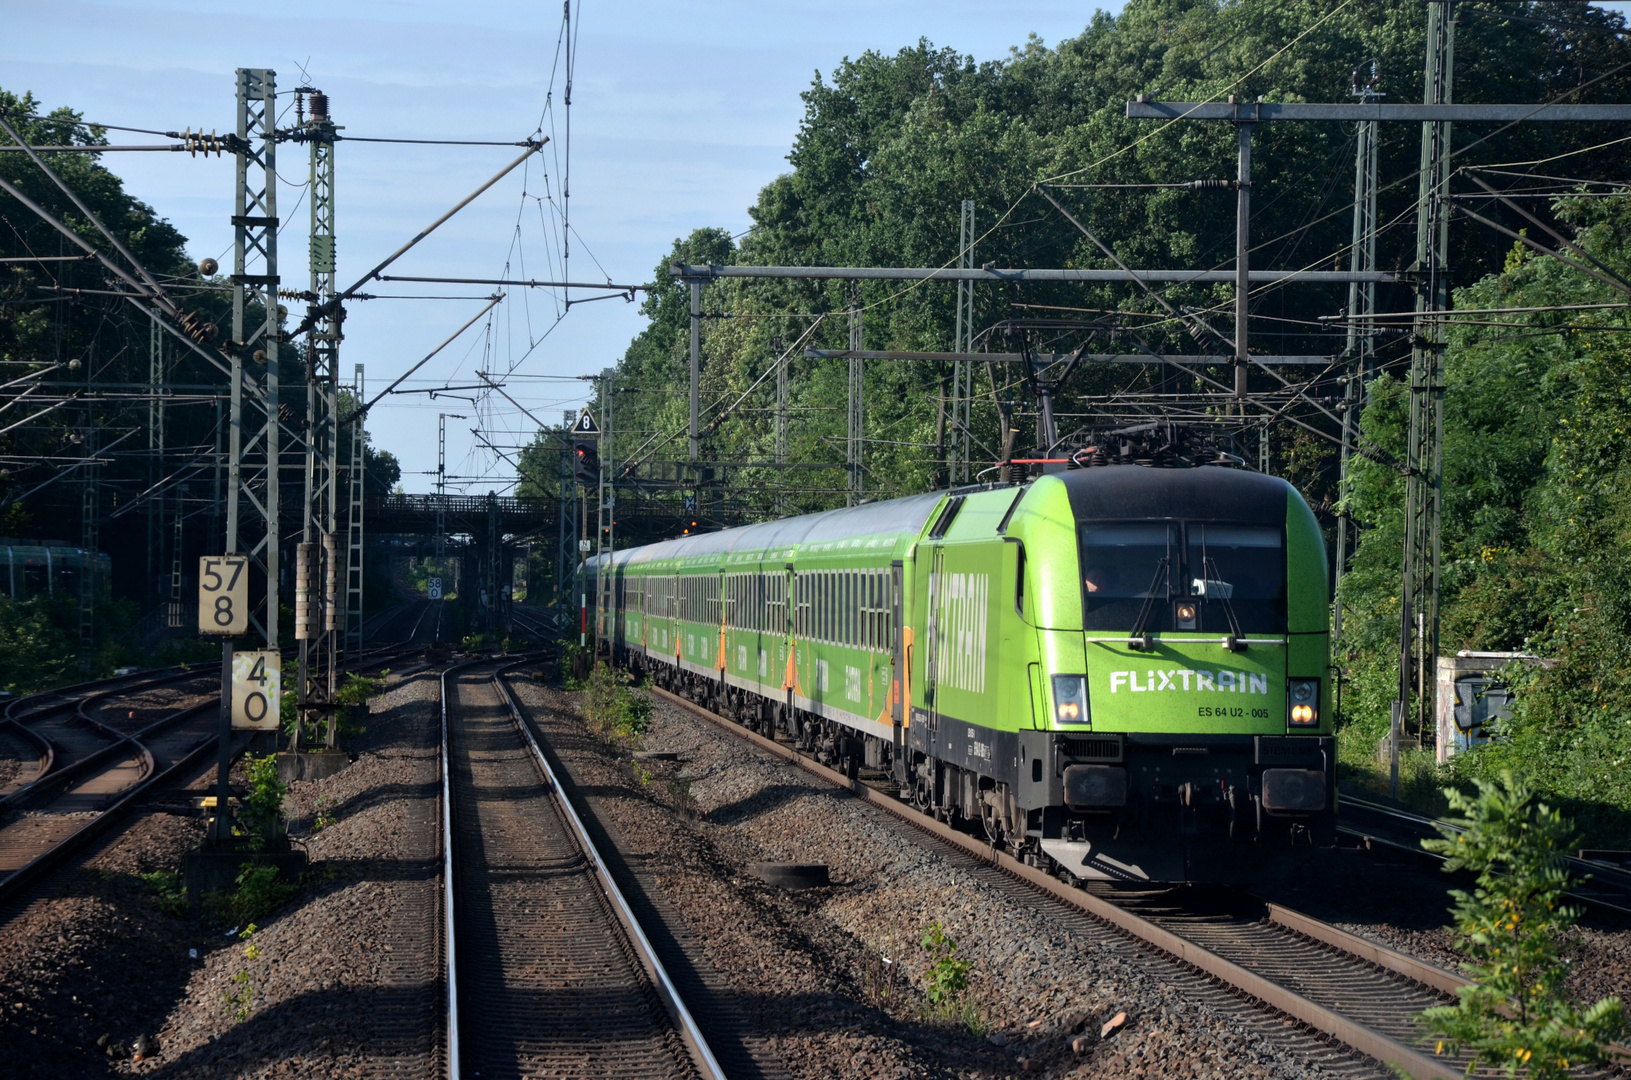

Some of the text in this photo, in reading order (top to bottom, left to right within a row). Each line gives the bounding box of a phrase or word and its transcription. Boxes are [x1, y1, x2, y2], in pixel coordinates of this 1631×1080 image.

[583, 415, 590, 430] 8
[202, 560, 245, 592] 57
[429, 578, 441, 588] 58
[431, 588, 438, 598] 0
[214, 595, 234, 626] 8
[246, 656, 267, 687] 4
[244, 691, 268, 722] 0
[1198, 707, 1212, 717] ES
[1215, 707, 1227, 717] 64
[1230, 707, 1243, 717] U2
[1251, 708, 1269, 718] 005
[1263, 746, 1313, 755] SIEMENS
